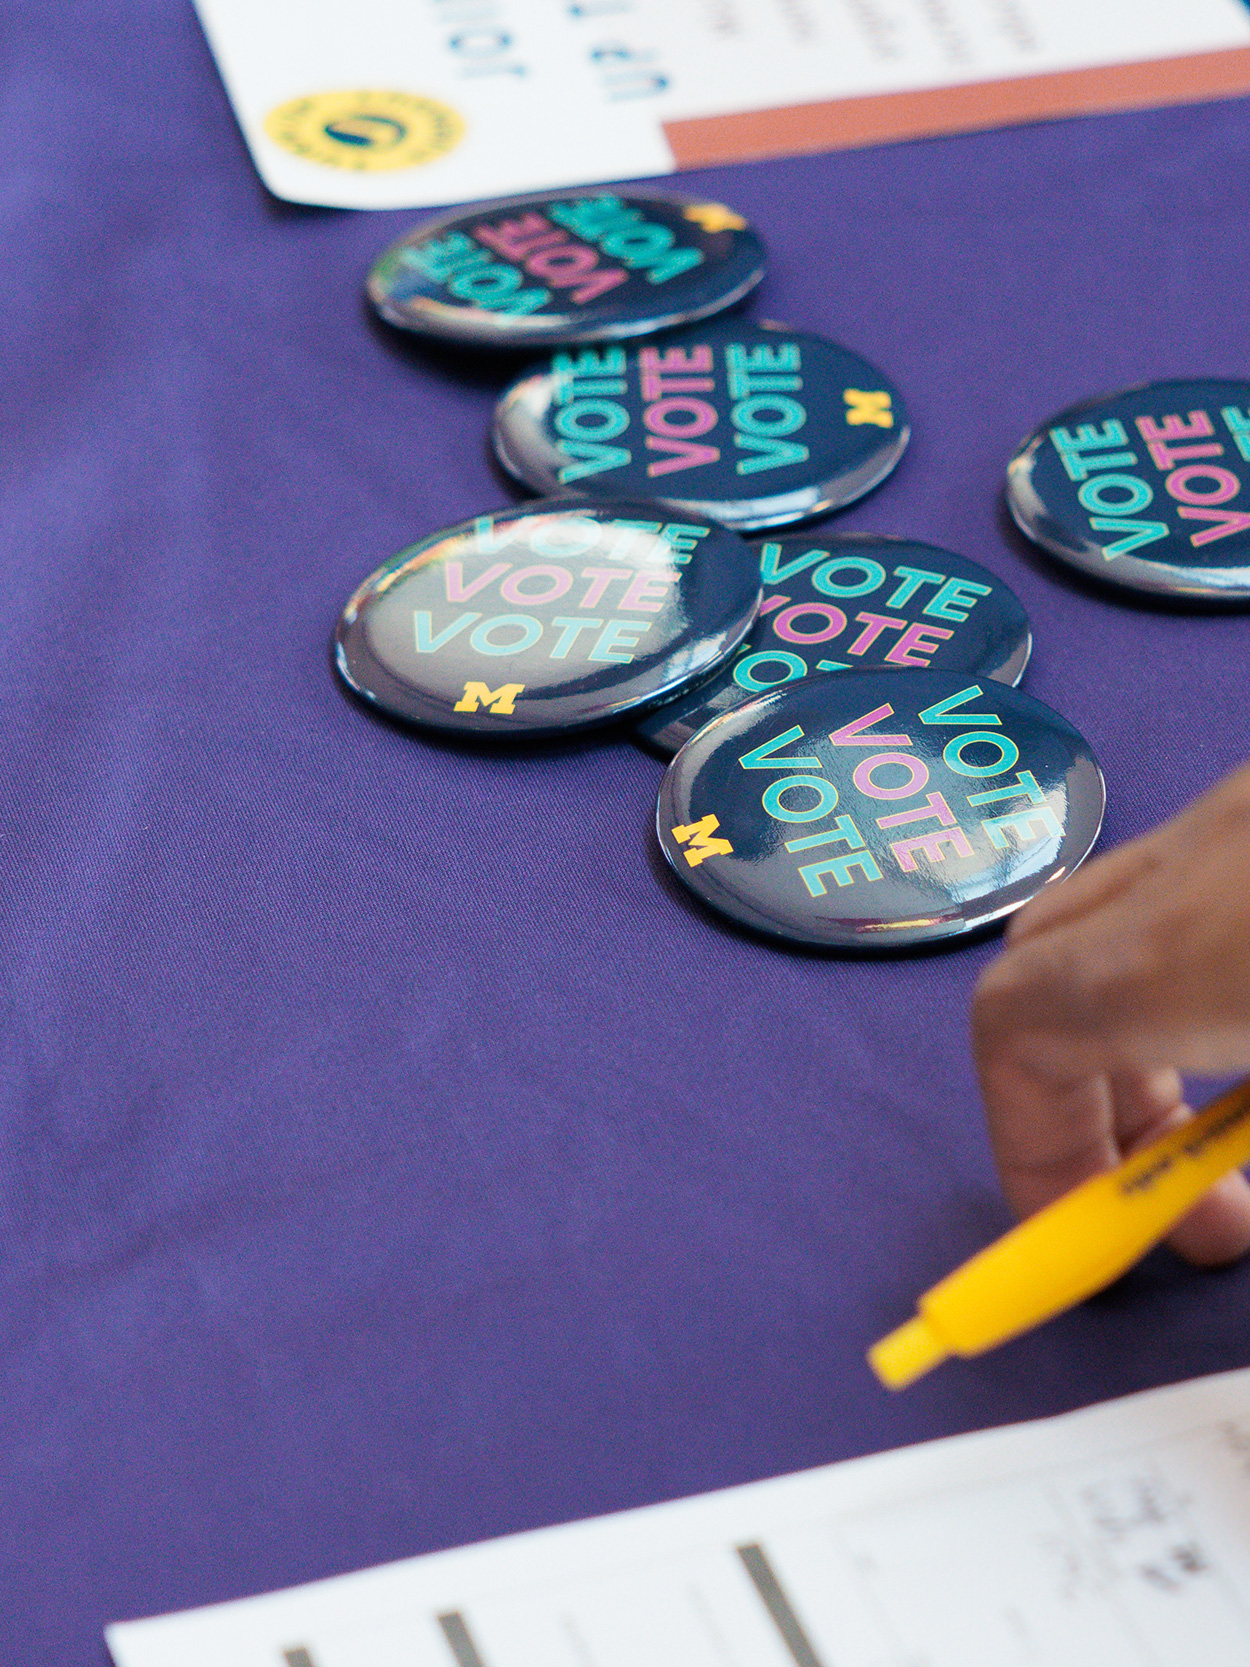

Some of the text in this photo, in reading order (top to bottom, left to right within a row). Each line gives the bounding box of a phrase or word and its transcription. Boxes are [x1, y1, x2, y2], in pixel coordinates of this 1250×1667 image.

[401, 231, 551, 318] VOTE
[474, 212, 628, 304] VOTE
[549, 192, 704, 284] VOTE
[553, 346, 632, 484] VOTE
[638, 344, 720, 477] VOTE
[725, 343, 809, 476] VOTE
[1049, 418, 1169, 561] VOTE
[445, 561, 682, 612] VOTE
[474, 516, 710, 565] VOTE
[760, 542, 993, 623] VOTE
[413, 610, 652, 664] VOTE
[453, 681, 525, 714] M
[738, 724, 883, 898] VOTE
[828, 703, 974, 872] VOTE
[918, 685, 1066, 850] VOTE
[671, 813, 734, 868] M
